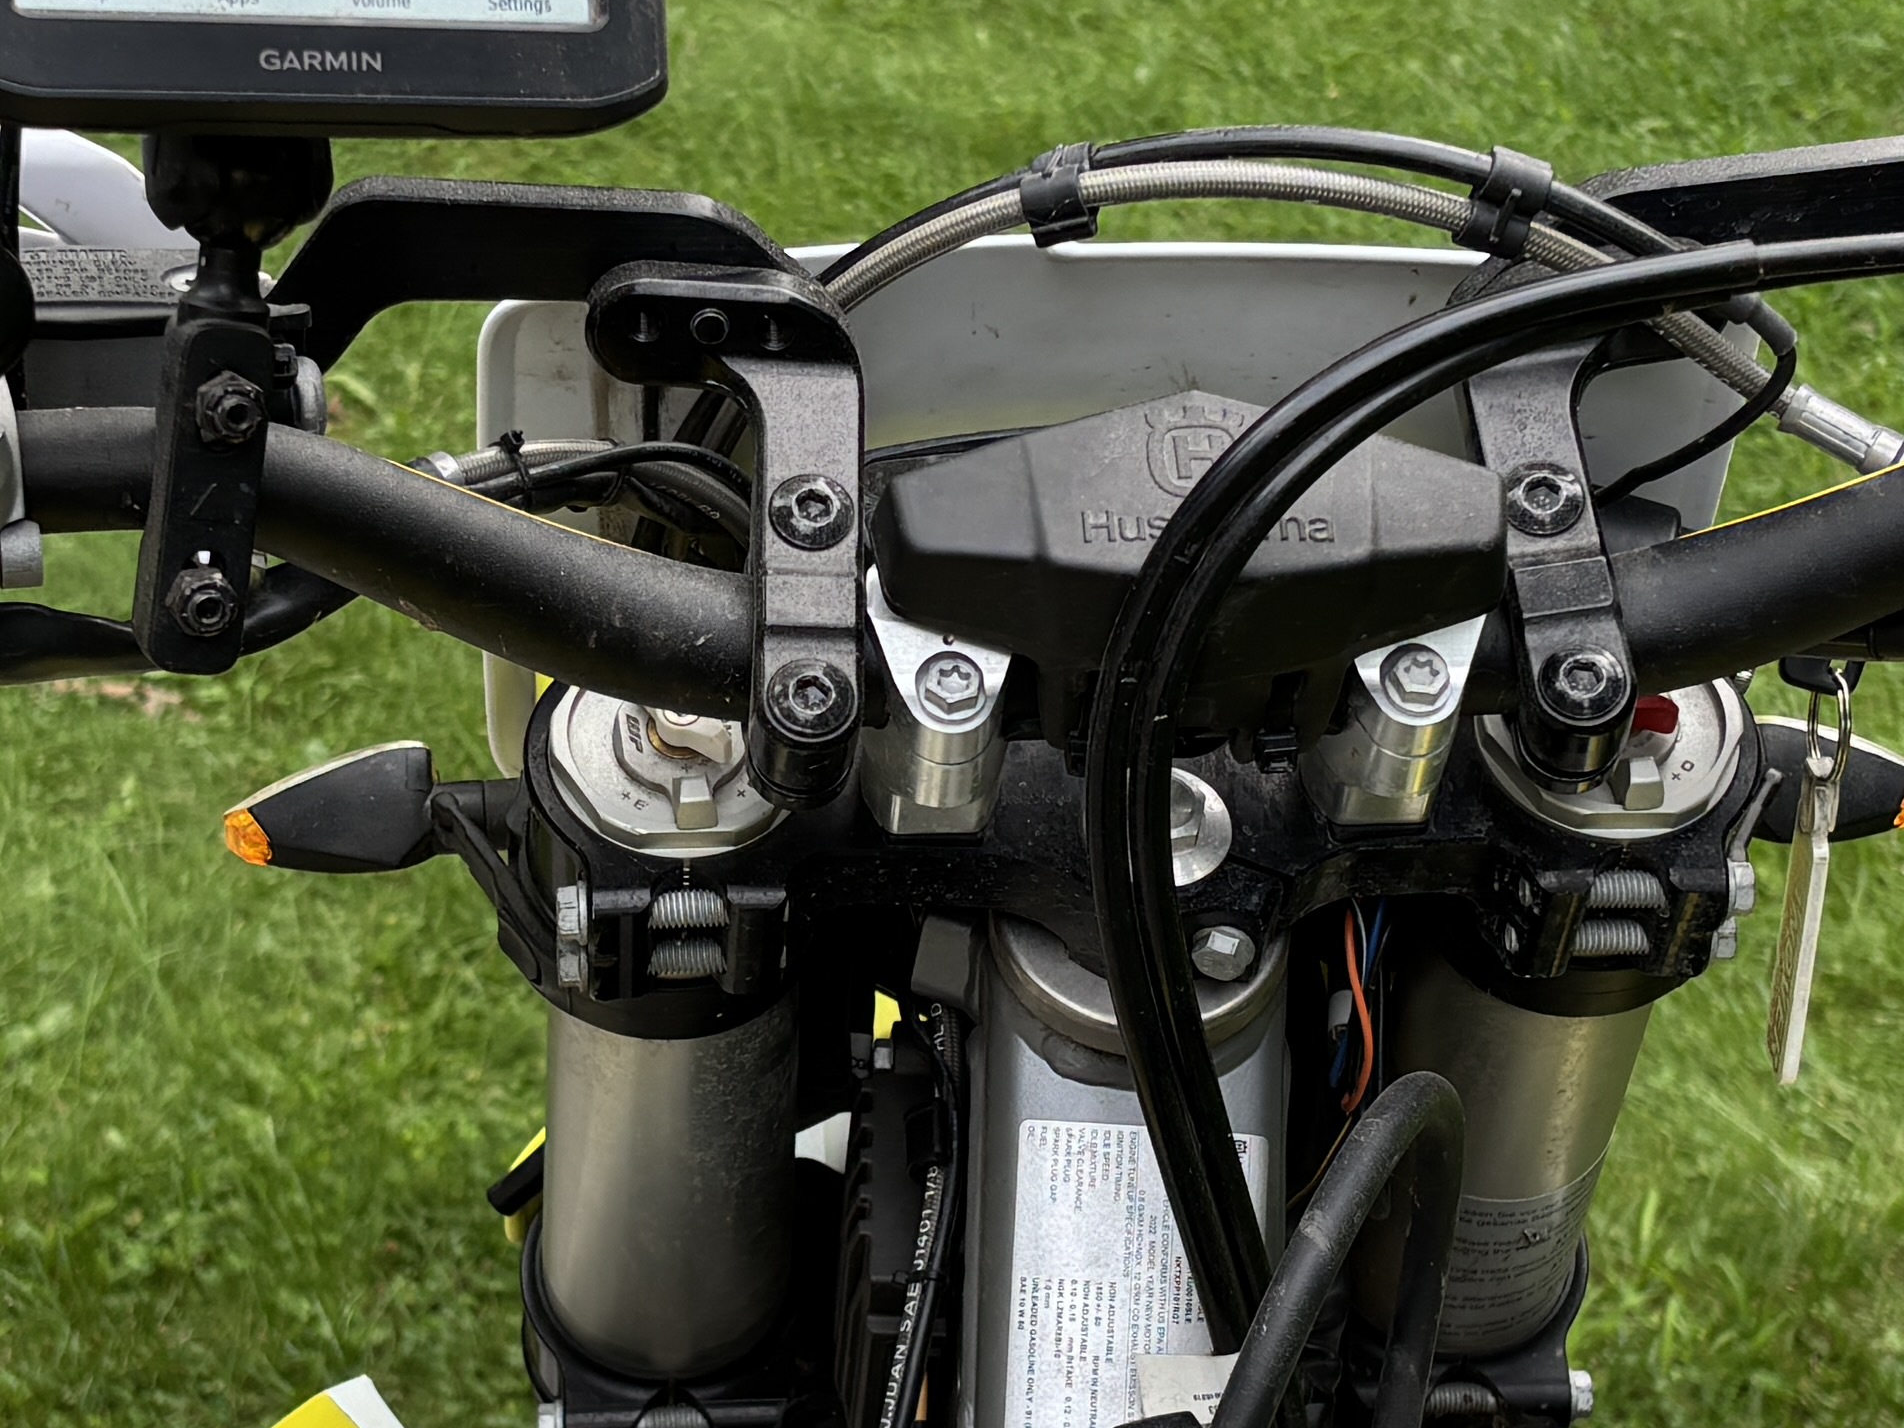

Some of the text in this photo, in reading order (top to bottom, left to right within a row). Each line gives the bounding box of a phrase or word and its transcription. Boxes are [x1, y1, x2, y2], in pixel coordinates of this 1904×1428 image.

[258, 49, 383, 73] GARMIN
[1081, 509, 1335, 544] Husna
[1128, 1131, 1136, 1164] ENGINE
[1147, 1241, 1155, 1271] MODEL
[1030, 1277, 1039, 1326] UNLEADED
[1145, 1275, 1153, 1298] YEAR
[900, 1283, 920, 1333] SAE
[1079, 1302, 1089, 1362] ADJUSTABLE
[1105, 1304, 1115, 1363] ADJUSTABLE
[1157, 1327, 1165, 1344] EPA
[1027, 1329, 1037, 1375] GASOLINE
[1025, 1377, 1036, 1402] ONLY
